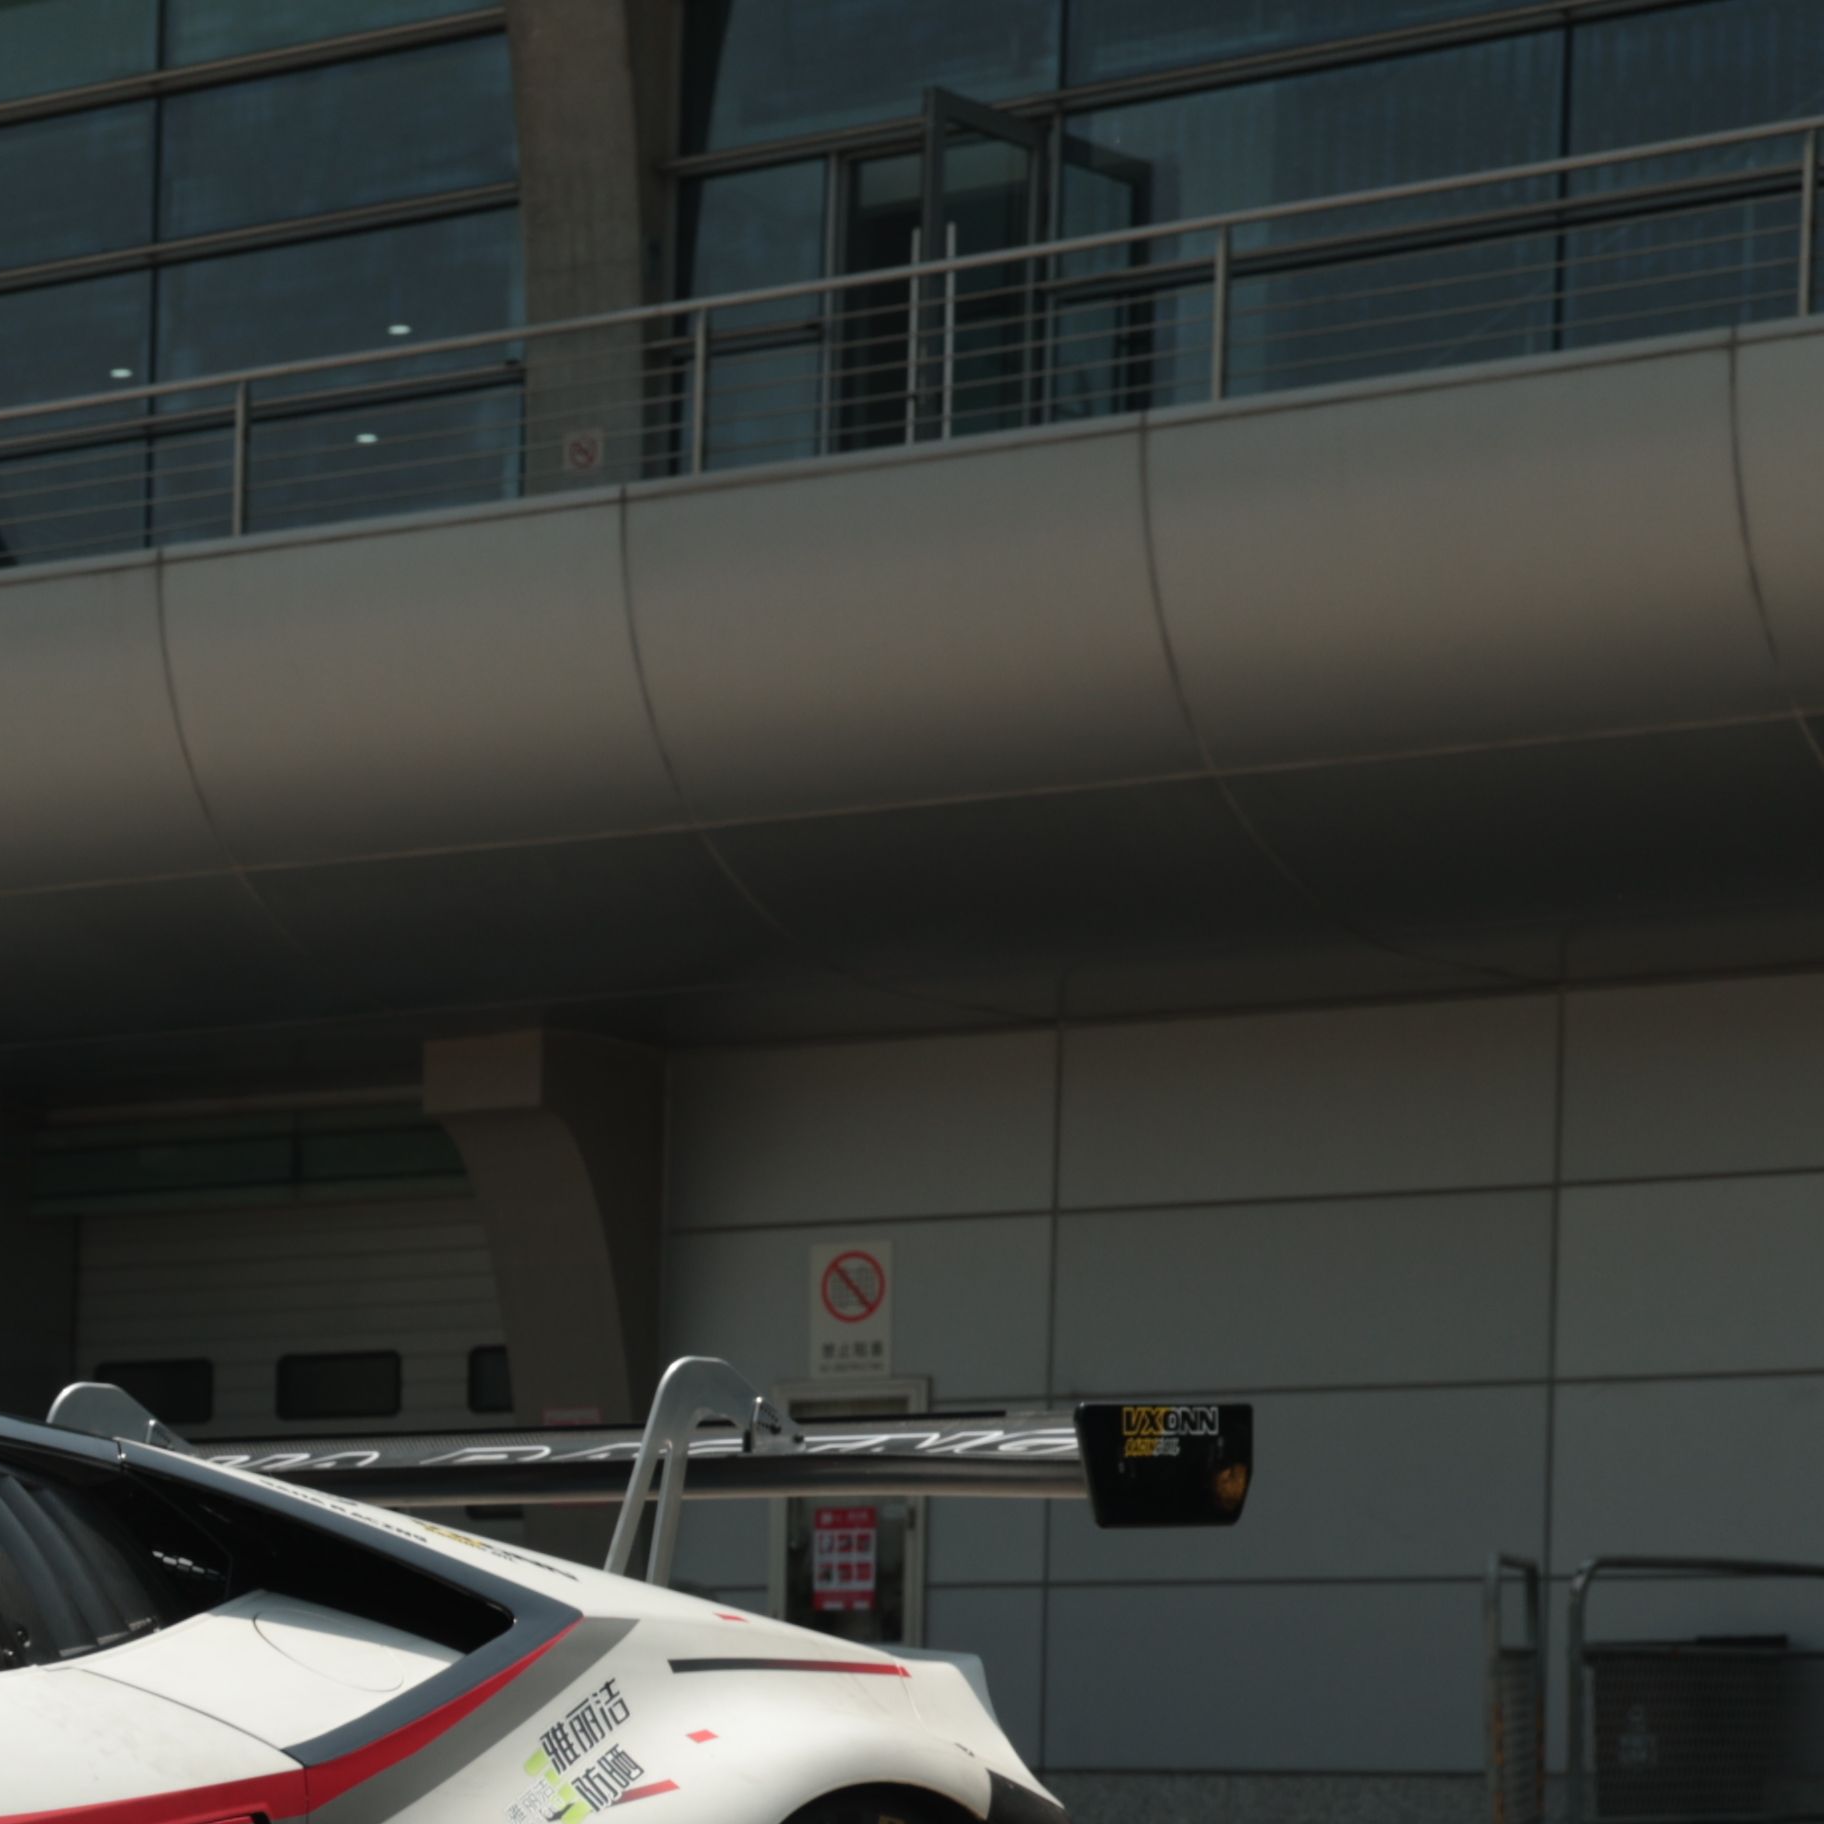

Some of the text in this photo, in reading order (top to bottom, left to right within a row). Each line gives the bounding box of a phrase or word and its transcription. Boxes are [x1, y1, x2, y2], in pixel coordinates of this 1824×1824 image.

[539, 1678, 630, 1775] 雅丽洁
[571, 1744, 645, 1812] 防晒
